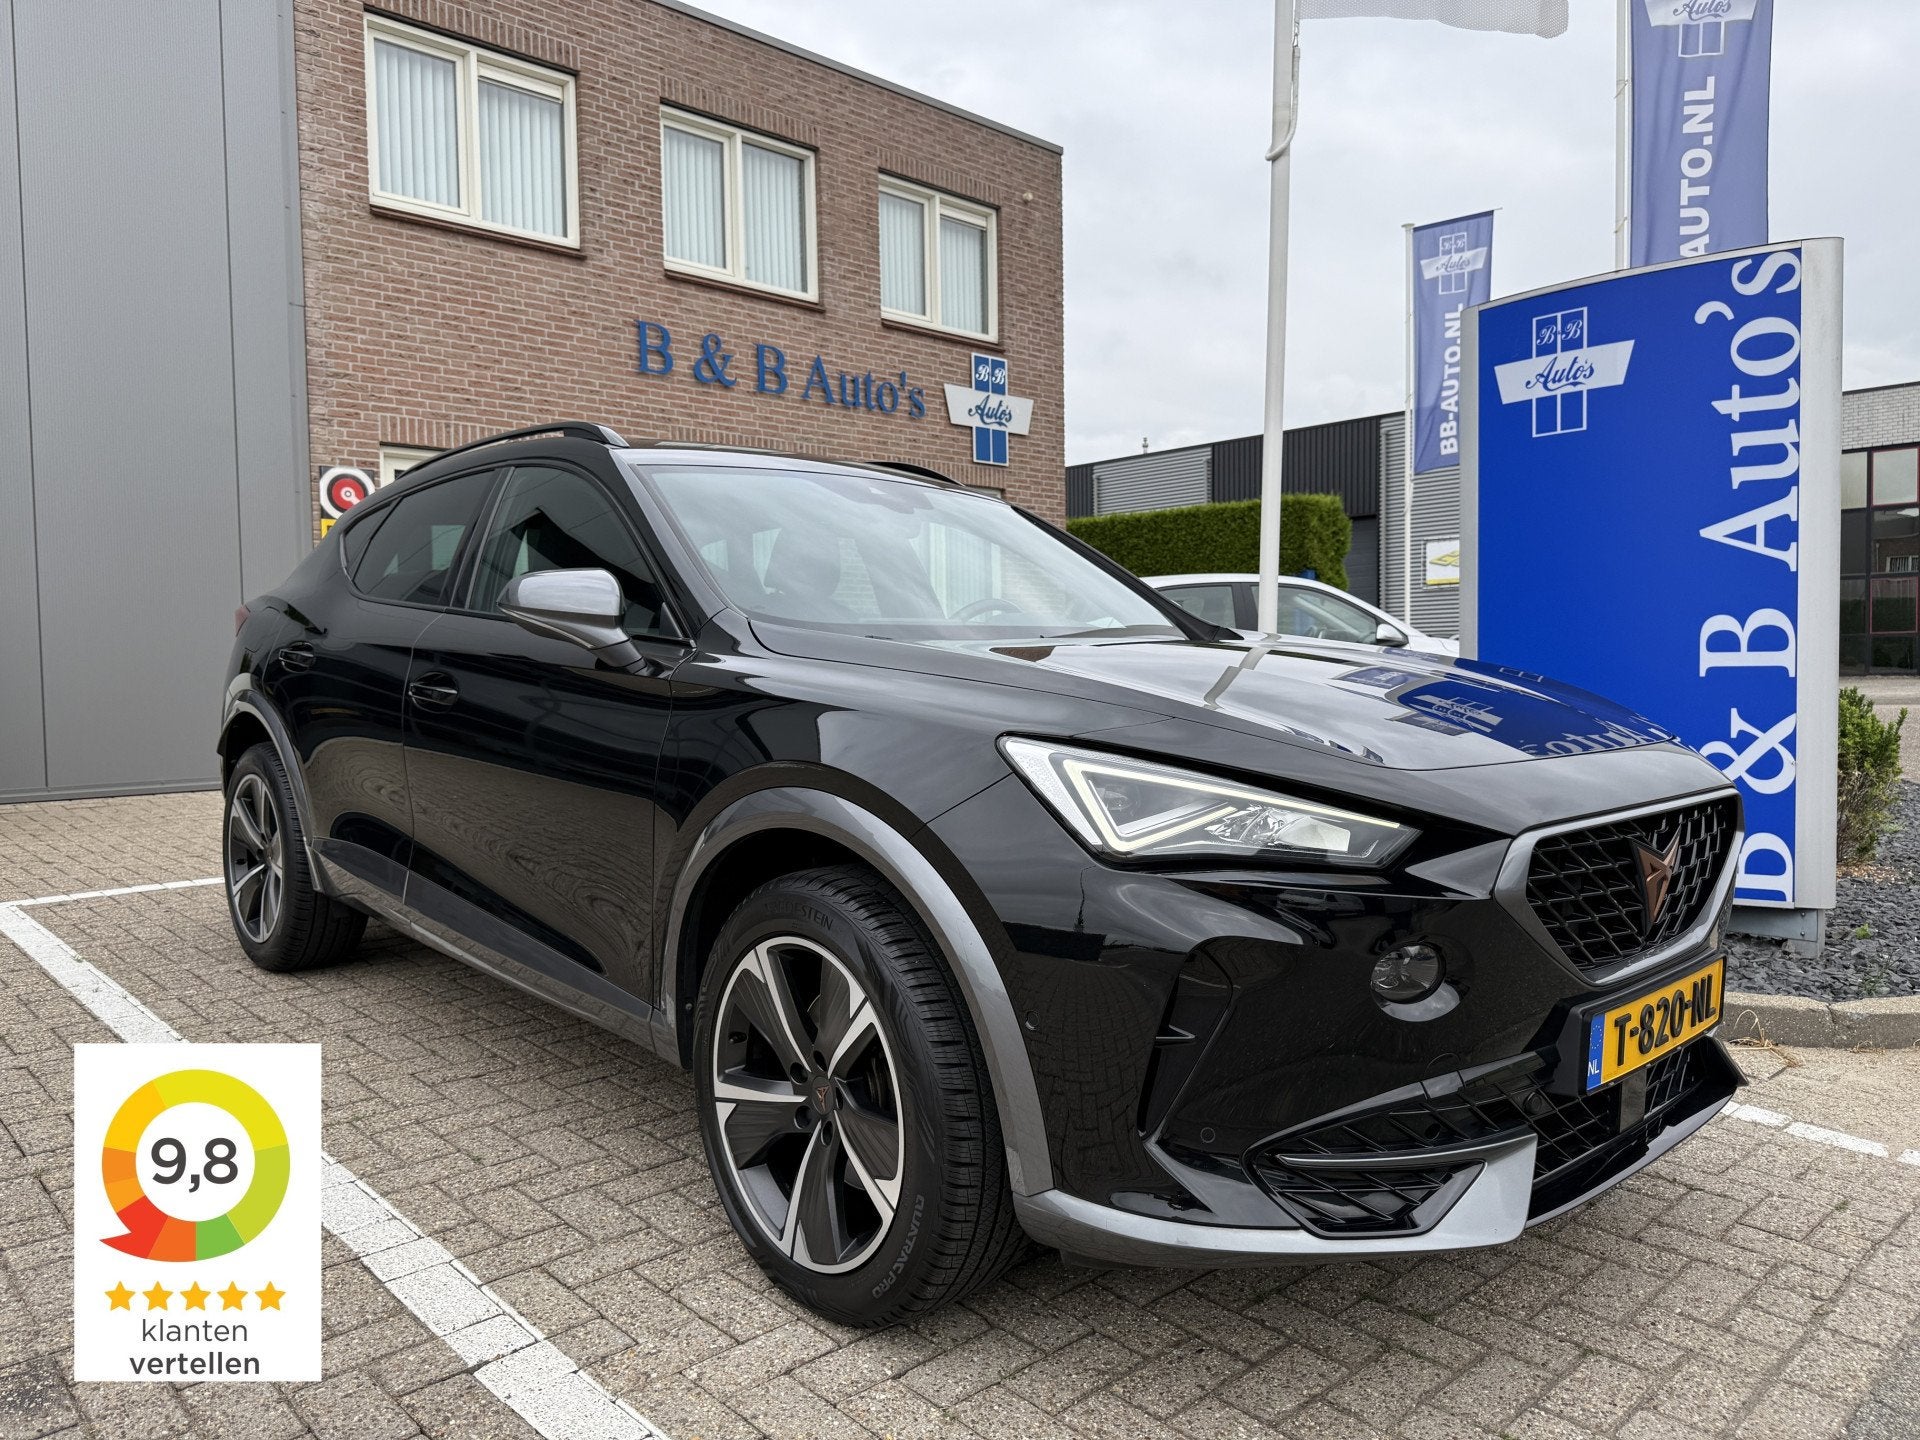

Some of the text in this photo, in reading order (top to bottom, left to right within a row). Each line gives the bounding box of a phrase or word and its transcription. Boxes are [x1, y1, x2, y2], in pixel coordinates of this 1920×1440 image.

[635, 319, 926, 419] B & B Auto's
[968, 394, 1012, 427] Auto's
[1440, 303, 1463, 455] BB-AUTO.NL
[1525, 356, 1594, 391] Auto's
[1694, 251, 1801, 572] Auto's
[1700, 608, 1796, 677] B
[1699, 708, 1796, 794] &
[1614, 973, 1716, 1067] T-820-NL
[1587, 1058, 1600, 1077] NL
[871, 1194, 925, 1299] QUATRAC PRO
